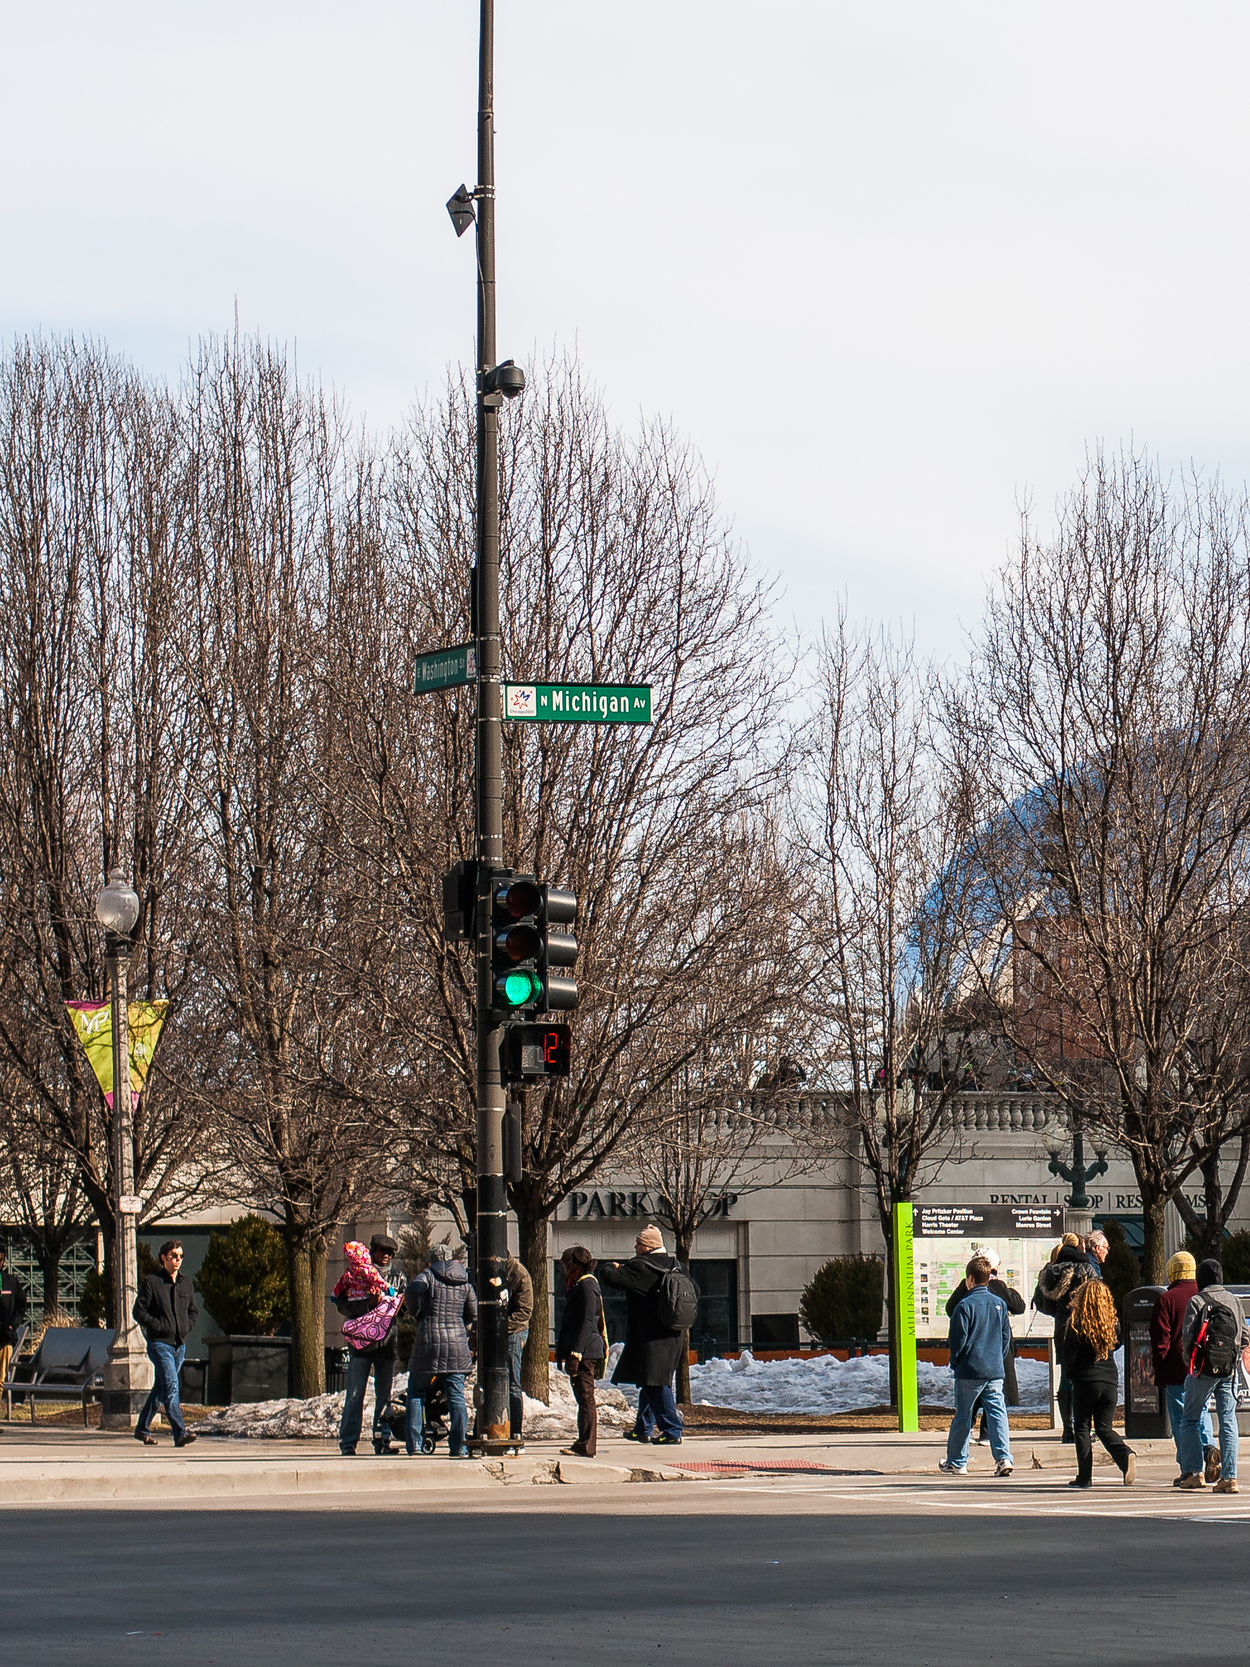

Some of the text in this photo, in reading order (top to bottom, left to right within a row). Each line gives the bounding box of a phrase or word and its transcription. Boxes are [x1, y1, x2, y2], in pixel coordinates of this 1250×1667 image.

[417, 657, 465, 683] E Washington St
[541, 690, 646, 719] N Michigan Av
[570, 1191, 739, 1217] PARK SOP
[1063, 1194, 1104, 1209] SOP
[1116, 1194, 1206, 1209] RESMS
[905, 1221, 915, 1336] MILLENNIUM PARK
